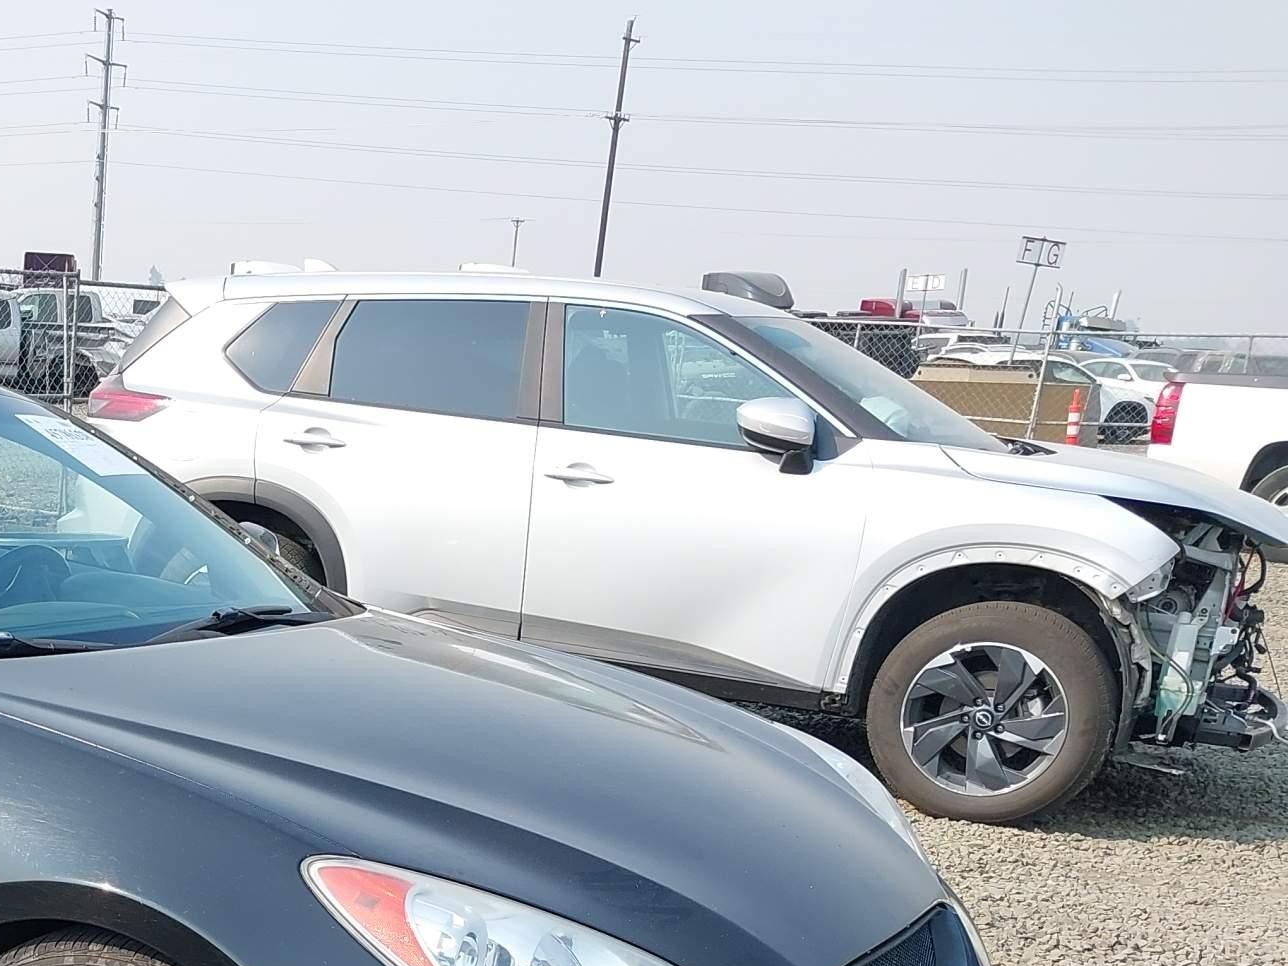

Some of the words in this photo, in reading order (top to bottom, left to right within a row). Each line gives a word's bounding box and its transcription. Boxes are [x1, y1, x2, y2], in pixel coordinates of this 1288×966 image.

[1021, 239, 1035, 261] F
[1046, 243, 1060, 265] G
[912, 280, 919, 290] E
[931, 277, 941, 289] D
